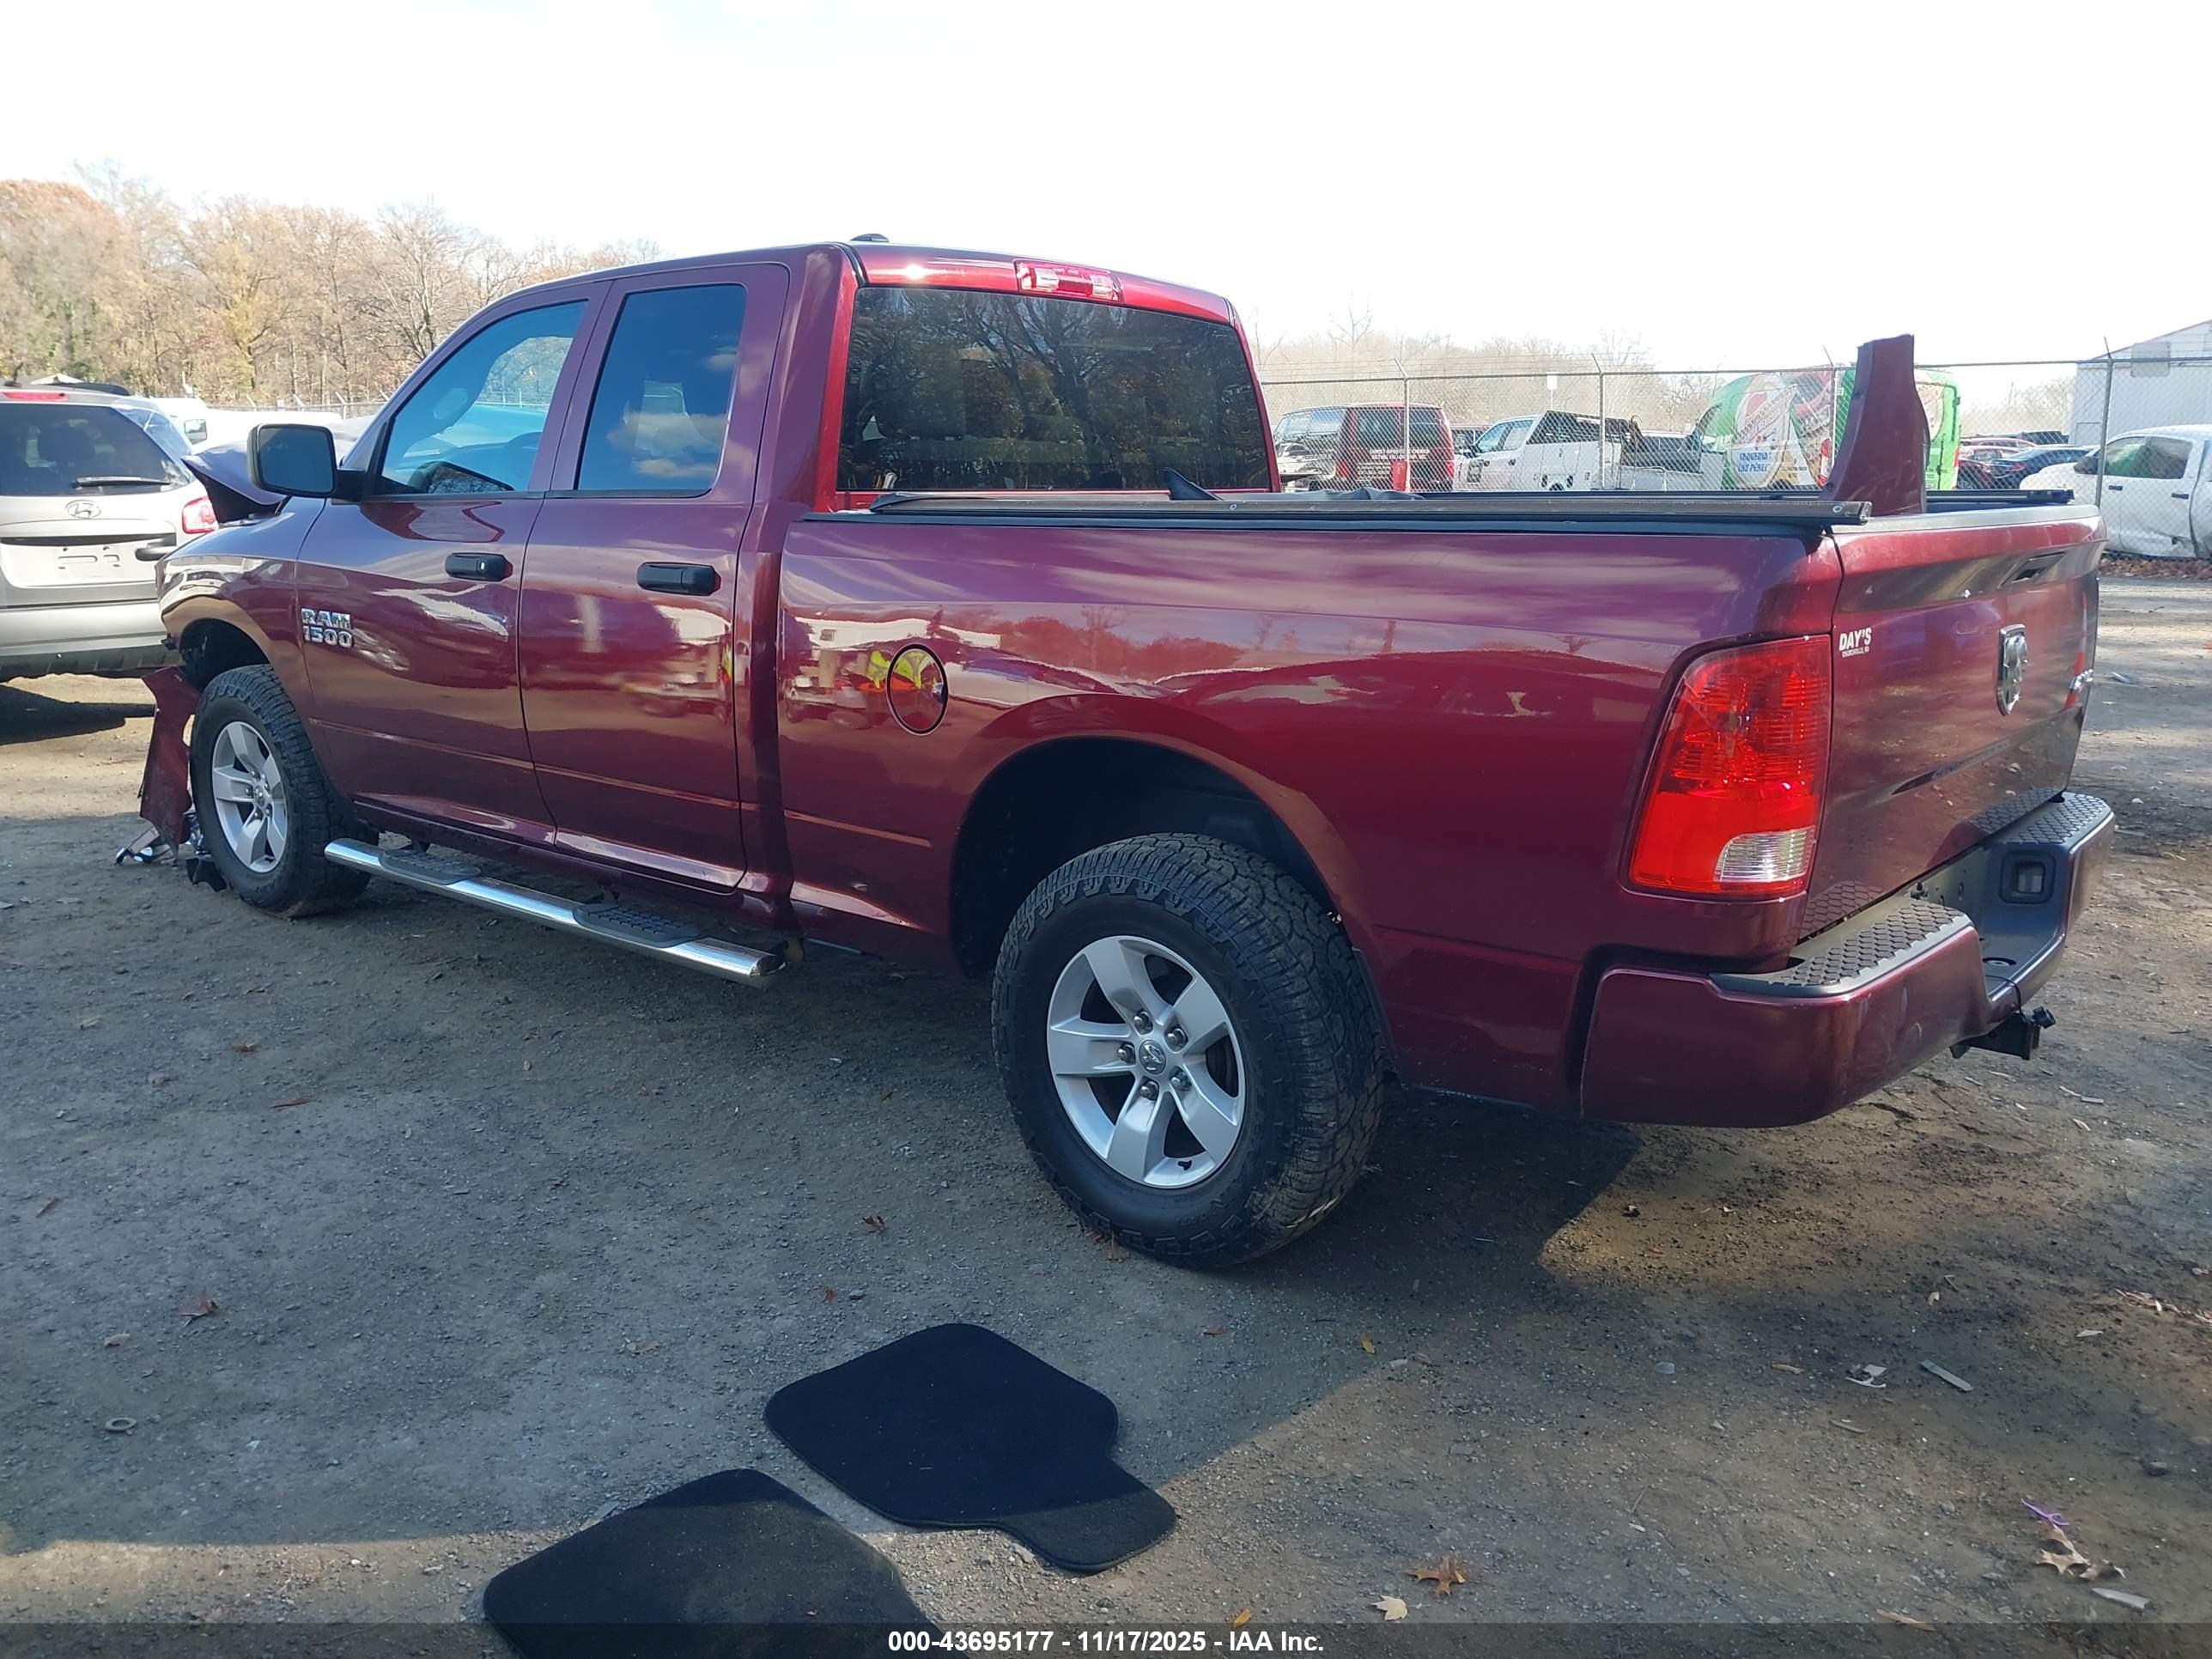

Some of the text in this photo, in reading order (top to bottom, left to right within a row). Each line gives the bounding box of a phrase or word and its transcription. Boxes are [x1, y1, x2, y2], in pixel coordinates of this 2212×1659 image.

[301, 607, 351, 629] RAM
[302, 625, 352, 648] 1500
[1838, 627, 1872, 651] DAY'S
